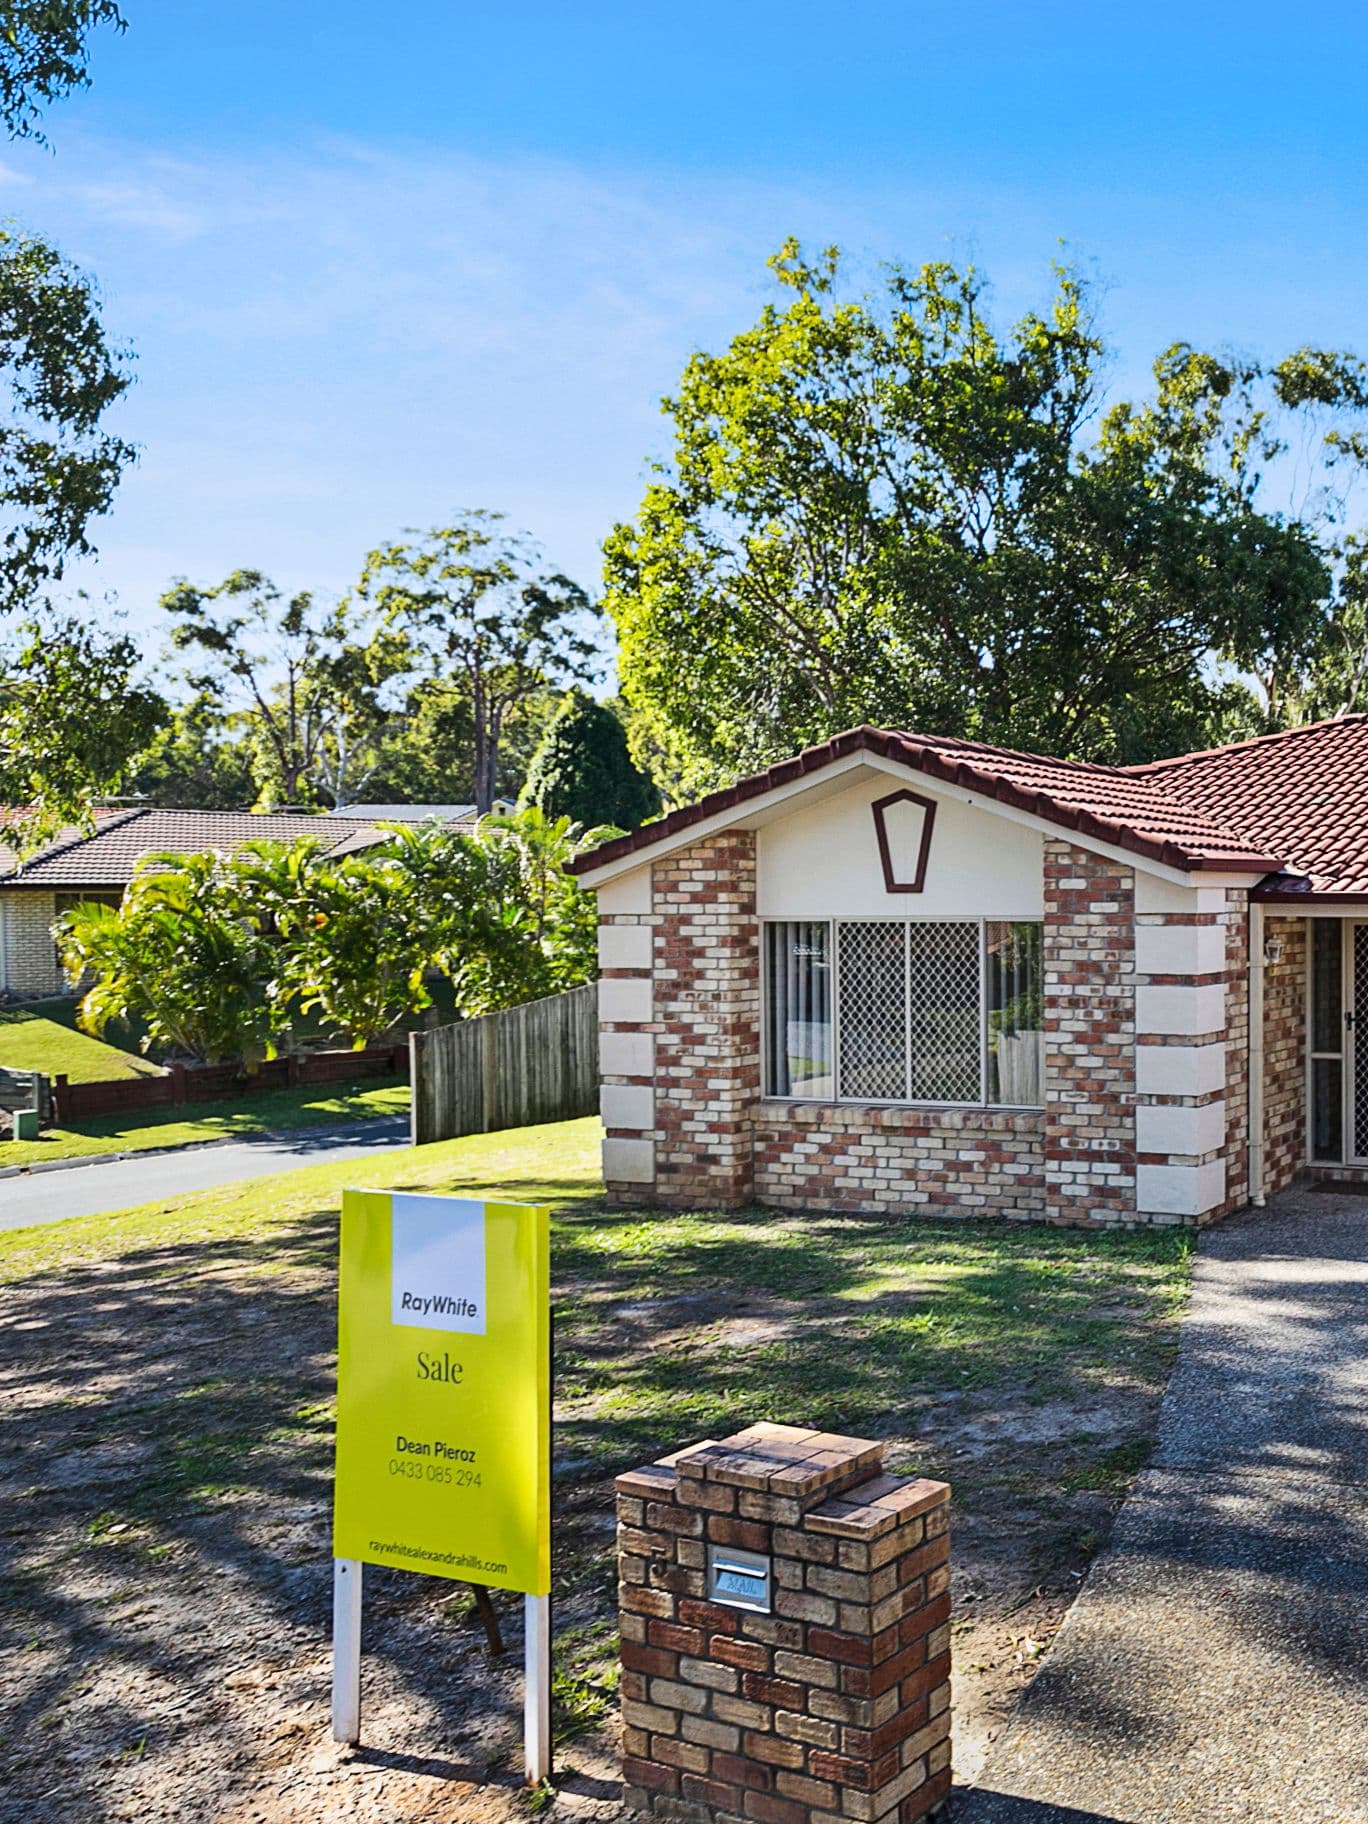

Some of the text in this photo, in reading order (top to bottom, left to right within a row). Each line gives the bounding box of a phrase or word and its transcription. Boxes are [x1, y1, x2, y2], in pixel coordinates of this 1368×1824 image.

[417, 1352, 464, 1384] Sale
[396, 1436, 476, 1463] Dean Pieroz
[388, 1459, 482, 1488] 0433 085 294
[369, 1540, 508, 1575] raywhitealexandrahills.com
[726, 1576, 758, 1595] MAIL
